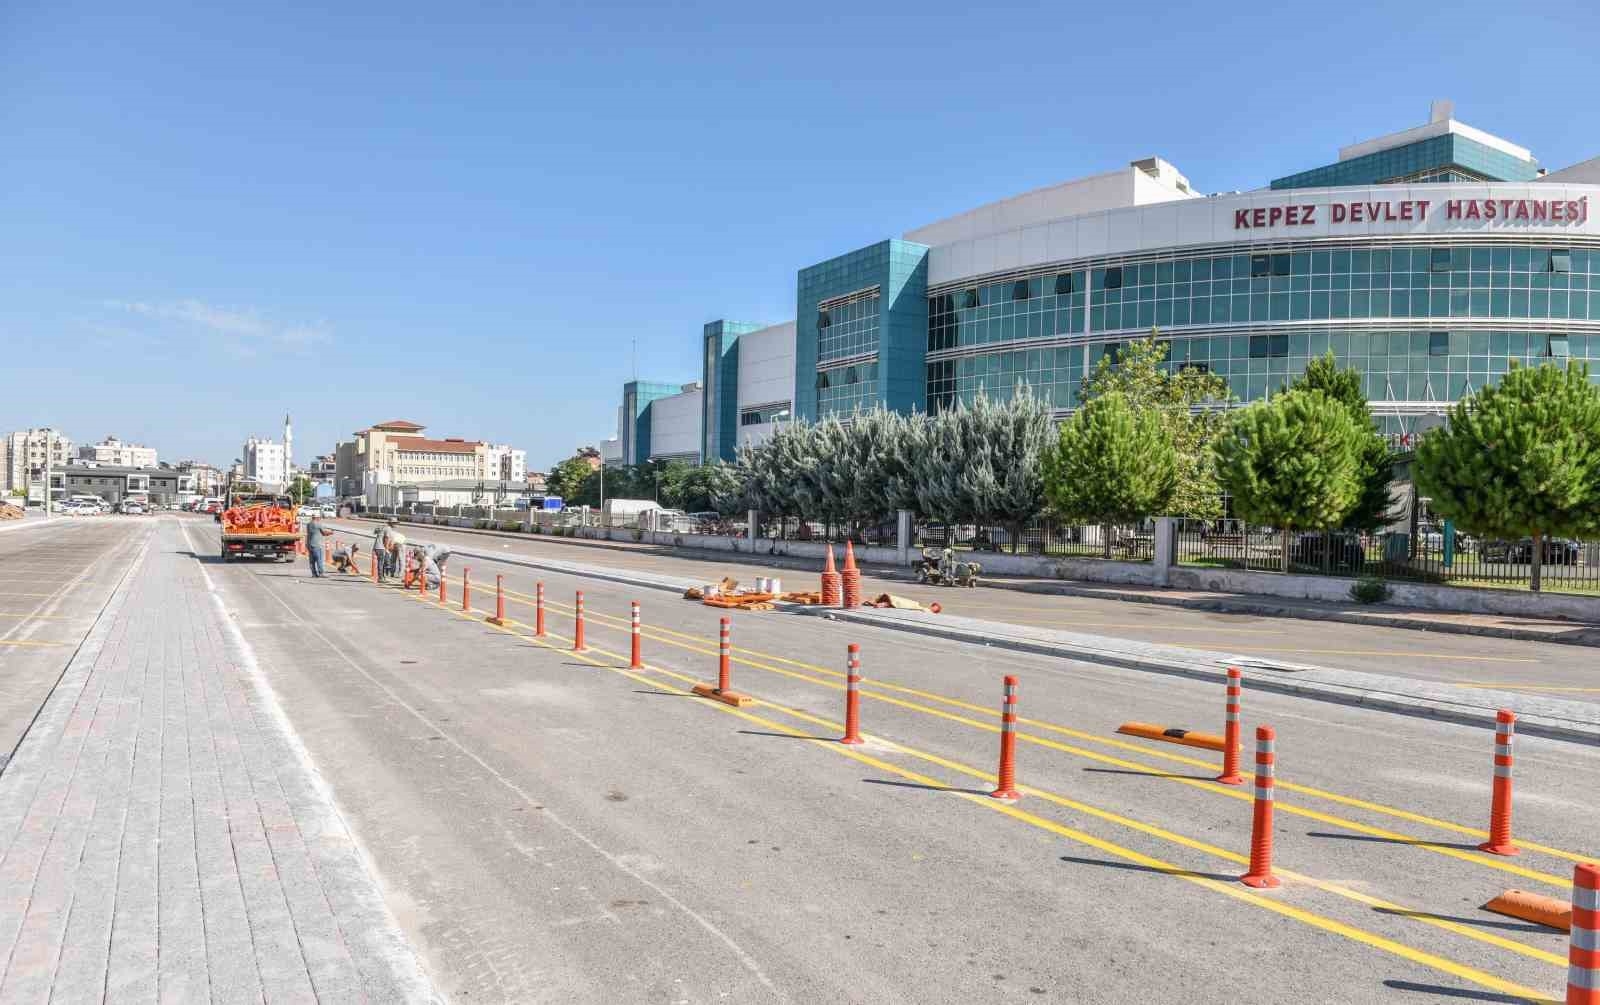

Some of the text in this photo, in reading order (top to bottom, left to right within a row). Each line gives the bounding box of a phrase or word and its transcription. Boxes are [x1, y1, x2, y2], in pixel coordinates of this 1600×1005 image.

[1235, 195, 1588, 229] KEPEZ DEVLET HASTANESİ
